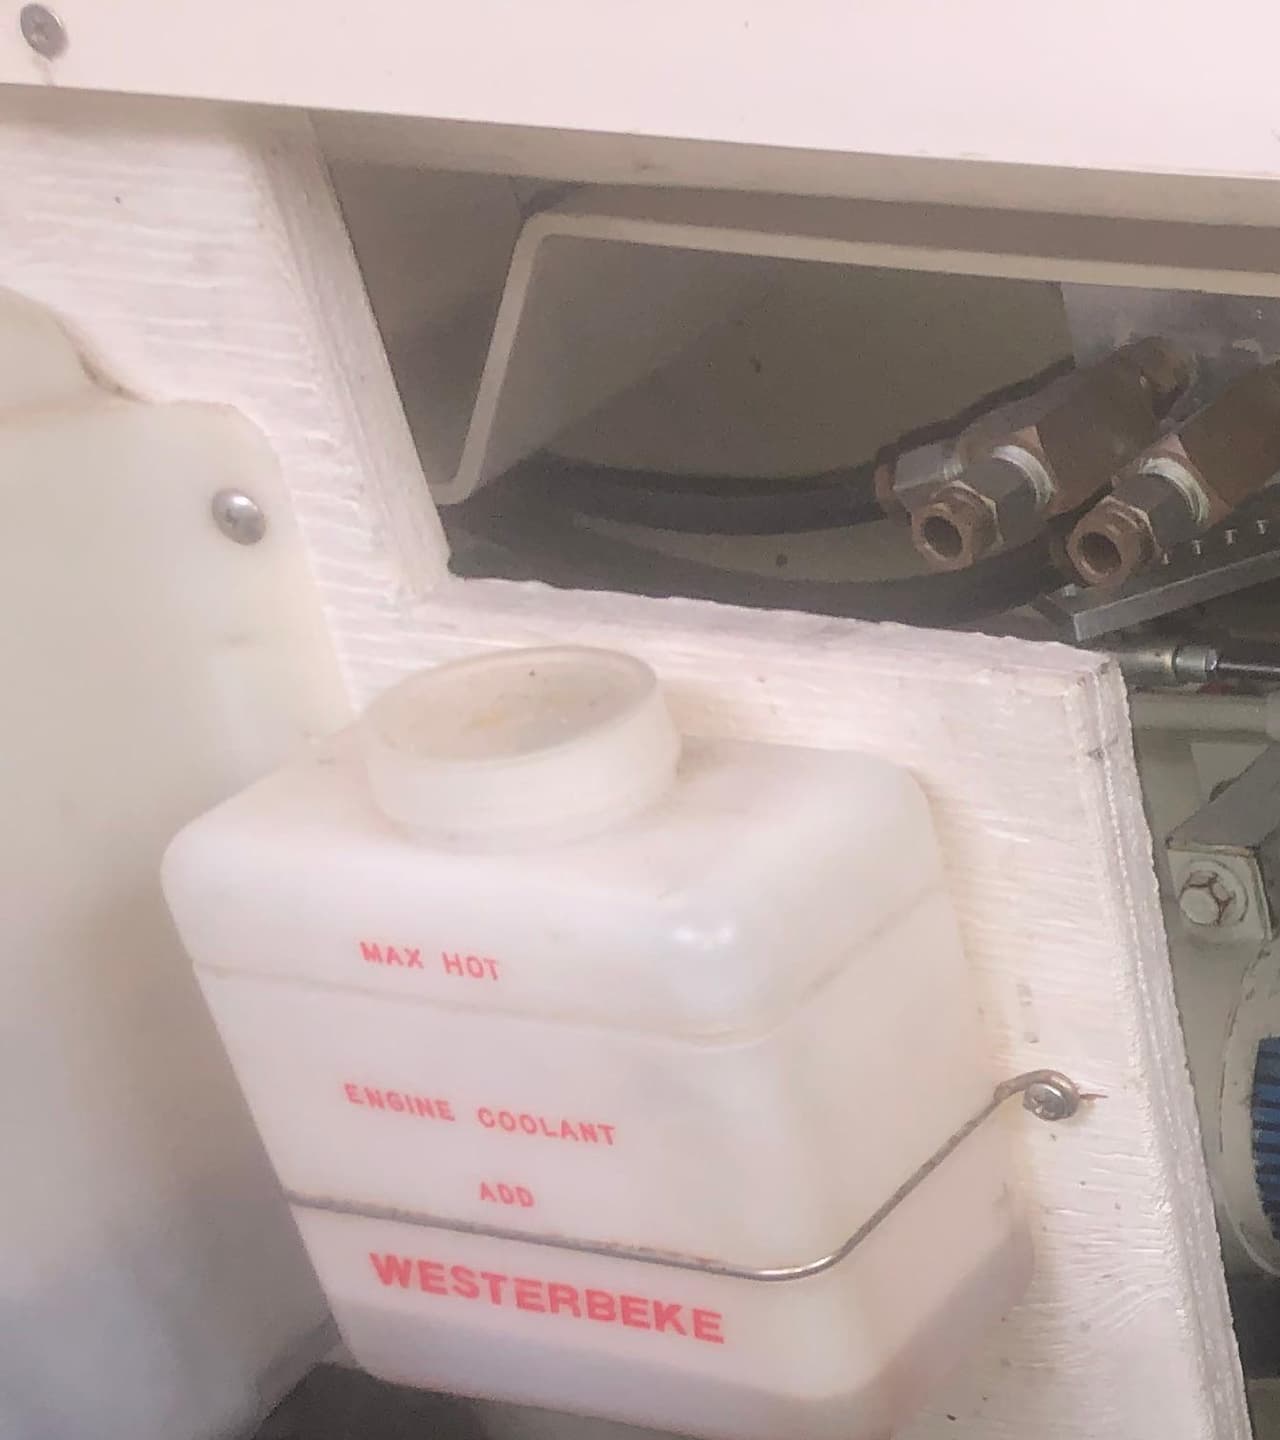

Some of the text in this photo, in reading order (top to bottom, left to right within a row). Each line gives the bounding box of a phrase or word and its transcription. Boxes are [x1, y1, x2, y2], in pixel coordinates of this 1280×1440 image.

[359, 941, 500, 981] MAX HOT
[344, 1084, 615, 1146] ENGINE COOLANT
[479, 1182, 535, 1208] ADD
[369, 1252, 726, 1344] WESTERBEKE
